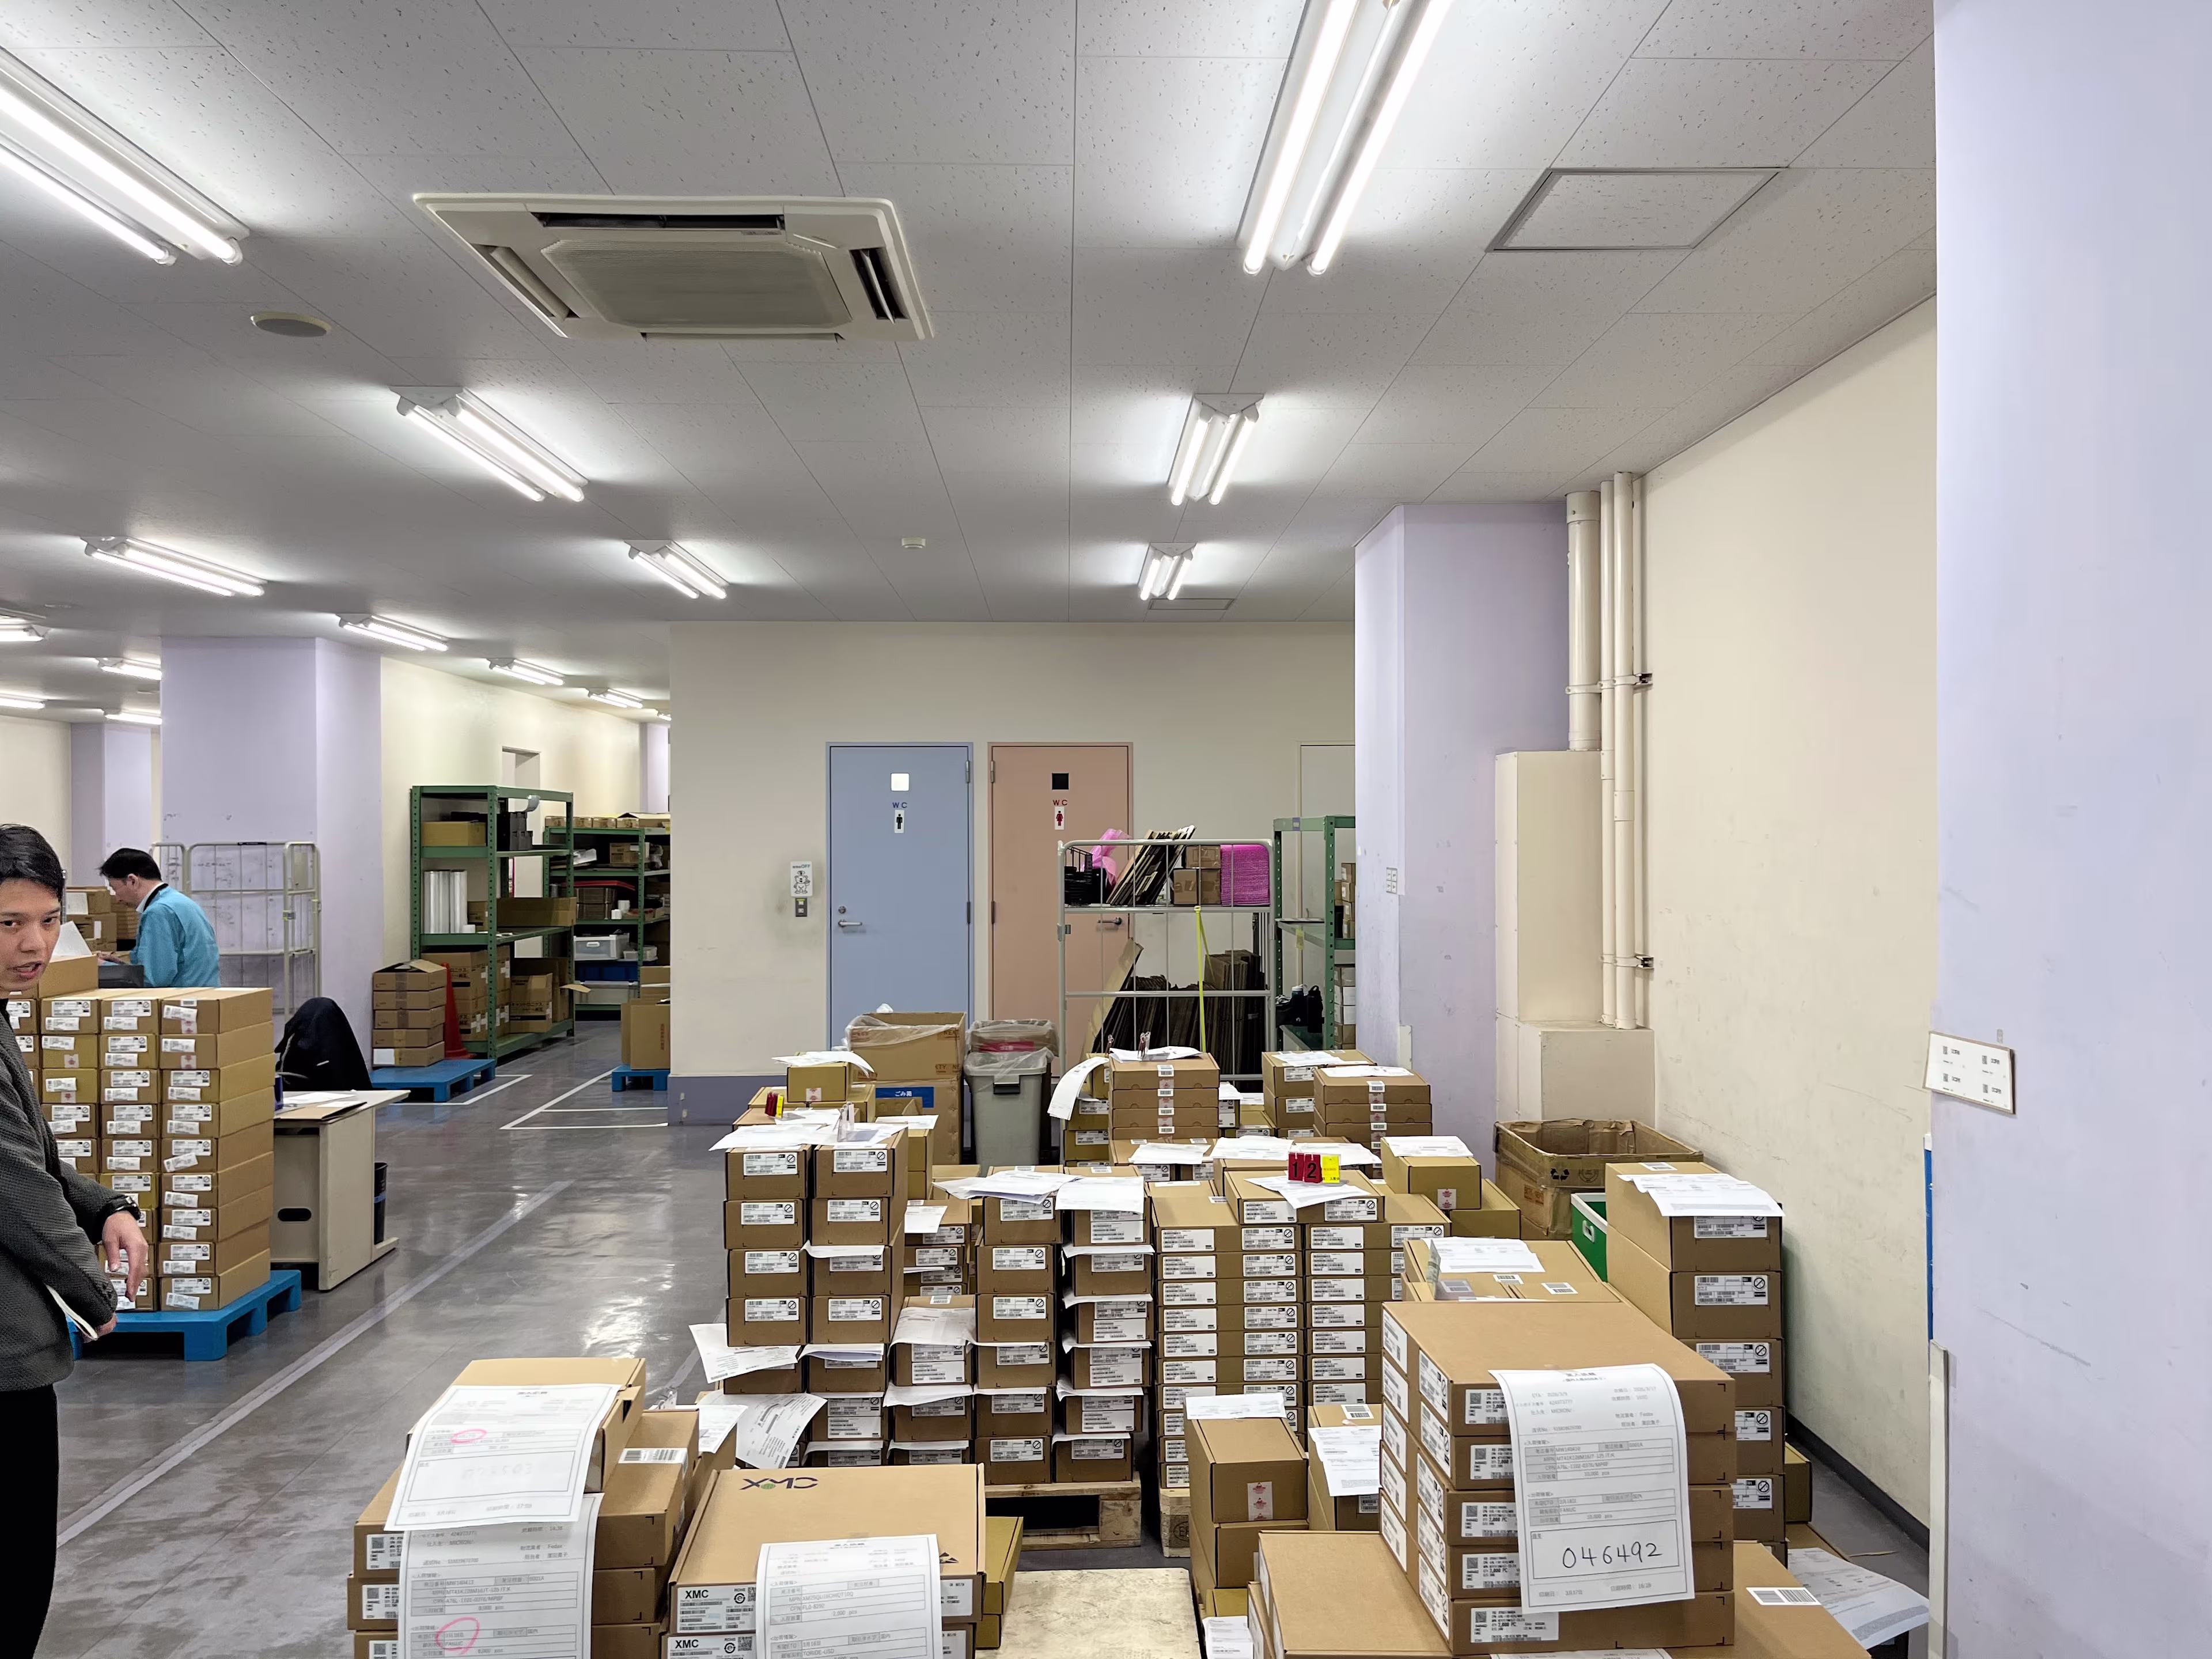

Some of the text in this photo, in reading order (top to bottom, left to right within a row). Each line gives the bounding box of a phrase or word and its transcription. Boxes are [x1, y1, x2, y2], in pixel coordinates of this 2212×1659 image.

[1292, 1161, 1317, 1179] 1 2
[1562, 1541, 1662, 1569] 046492
[685, 1589, 709, 1599] XMC
[675, 1639, 699, 1649] XMC
